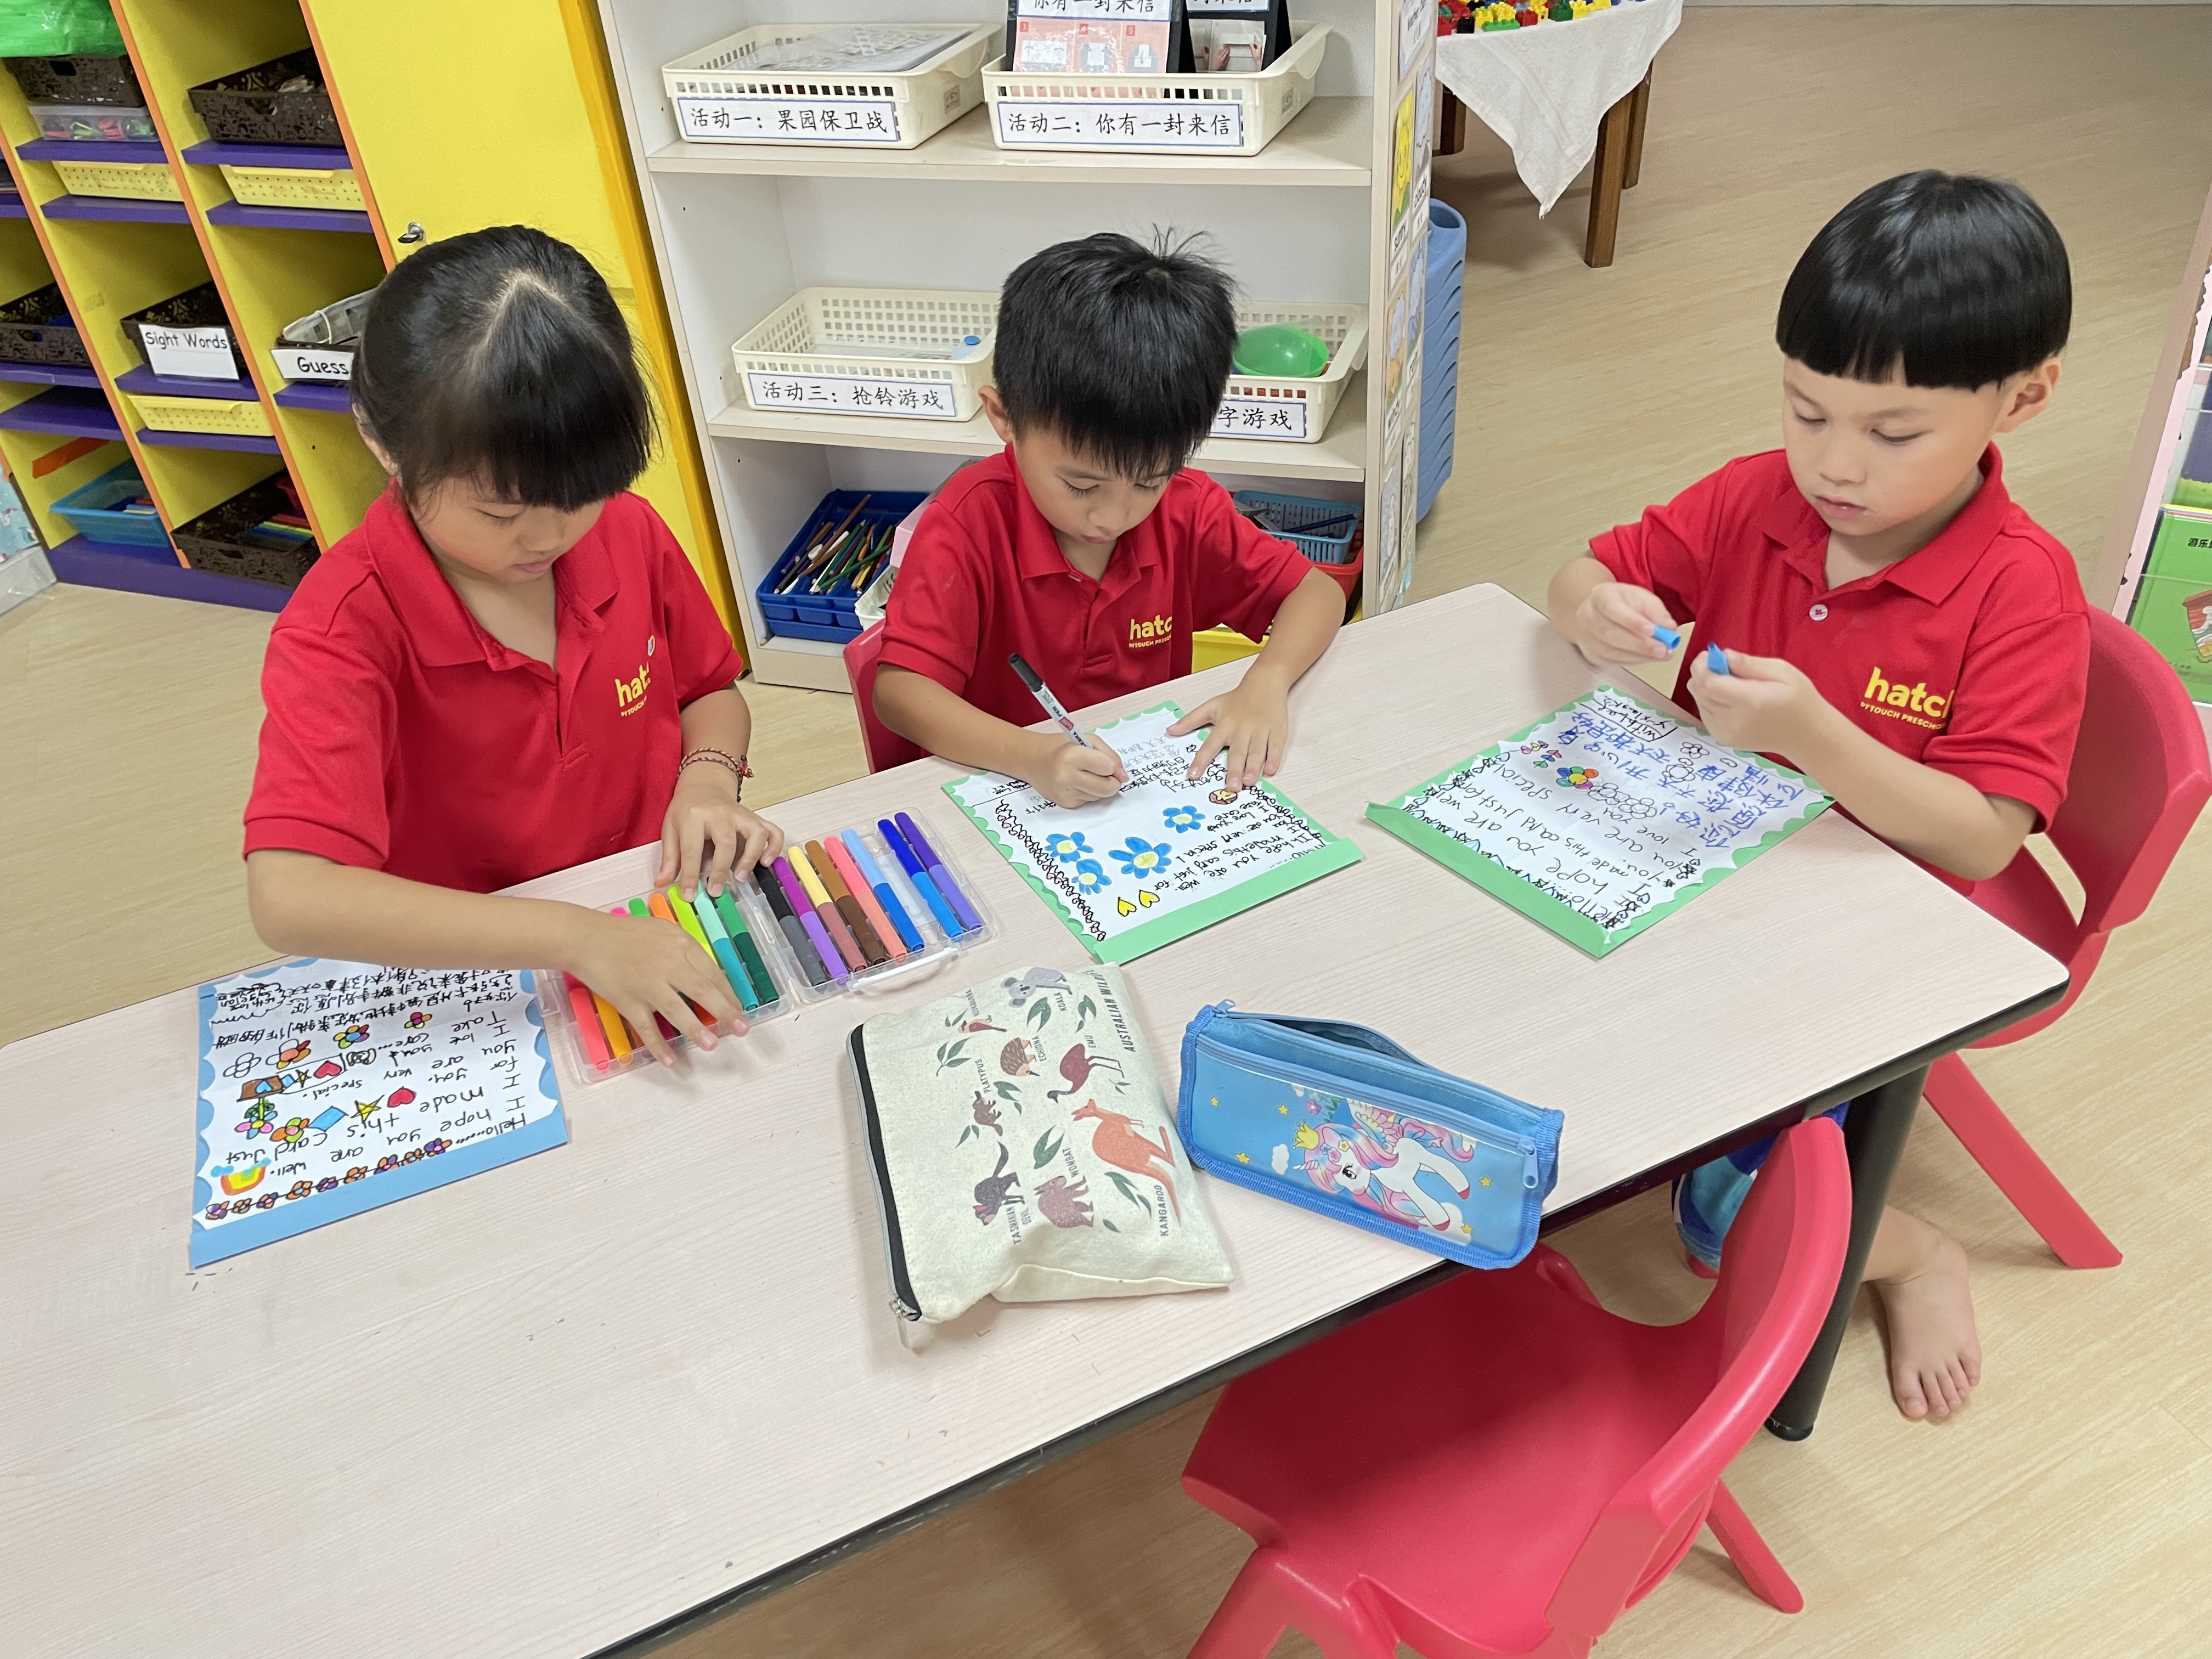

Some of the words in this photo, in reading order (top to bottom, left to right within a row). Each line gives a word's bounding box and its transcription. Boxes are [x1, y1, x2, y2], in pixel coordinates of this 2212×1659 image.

[691, 106, 887, 133] 活动一：果园保卫战
[1008, 111, 1231, 137] 活动二：你有一封来信
[145, 331, 179, 349] Sight
[183, 333, 228, 349] Words
[297, 356, 349, 375] Guess
[762, 381, 944, 410] 活动三：抢铃游戏
[1052, 706, 1063, 717] PEN
[1479, 795, 1524, 819] just
[1556, 803, 1600, 825] very
[1603, 807, 1633, 824] you
[1215, 810, 1240, 823] care
[1464, 811, 1502, 831] are
[1604, 826, 1643, 852] are
[1637, 826, 1669, 844] love
[1506, 837, 1544, 856] you
[1565, 838, 1590, 857] this
[1680, 848, 1697, 857] I
[1173, 867, 1195, 881] just
[1203, 867, 1227, 877] are
[1587, 857, 1629, 876] made
[1154, 880, 1173, 890] for
[1613, 895, 1632, 907] I
[1053, 991, 1068, 1012] KOALA
[451, 1011, 506, 1032] Take
[493, 1024, 511, 1037] I
[1103, 998, 1136, 1053] AUSTRALIAN
[449, 1033, 475, 1045] love
[481, 1039, 517, 1055] you
[1084, 1035, 1097, 1048] EMU
[1032, 1035, 1047, 1062] ECHIDNA
[431, 1056, 464, 1069] are
[489, 1057, 518, 1072] for
[383, 1068, 412, 1080] very
[428, 1068, 468, 1083] you.
[502, 1074, 521, 1090] I
[975, 1059, 991, 1094] PLATYPUS
[420, 1086, 484, 1112] made
[506, 1096, 526, 1112] I
[347, 1113, 399, 1138] this
[440, 1109, 492, 1132] hope
[386, 1128, 421, 1146] you
[330, 1147, 363, 1162] are
[1062, 1147, 1080, 1178] WOMBAT
[1154, 1184, 1169, 1237] KANGAROO
